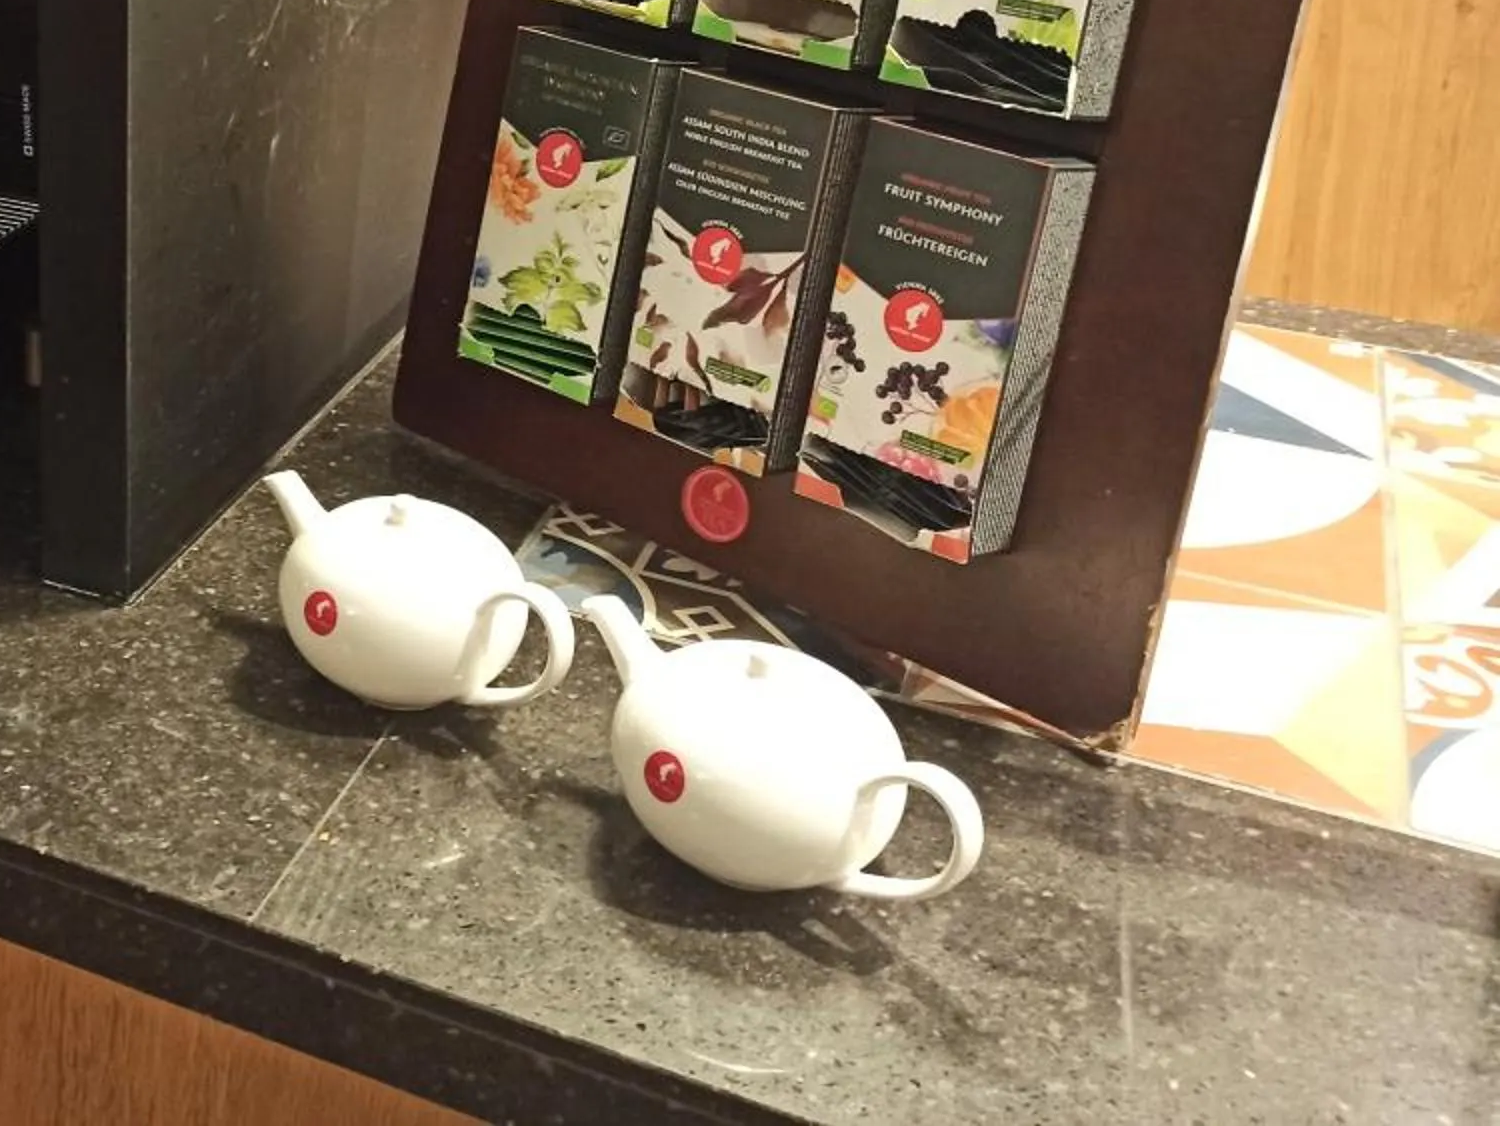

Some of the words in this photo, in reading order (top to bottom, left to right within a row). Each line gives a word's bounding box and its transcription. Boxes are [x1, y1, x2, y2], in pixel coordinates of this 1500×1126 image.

[683, 115, 713, 131] ASSAM
[713, 122, 747, 142] SOUTH
[747, 133, 776, 150] INDIA
[777, 141, 811, 158] BLEND
[749, 186, 807, 211] MISCHUNG
[883, 182, 923, 204] FRUIT
[923, 194, 1005, 228] SYMPHONY
[877, 222, 990, 268] FRÜCHTEREIGEN
